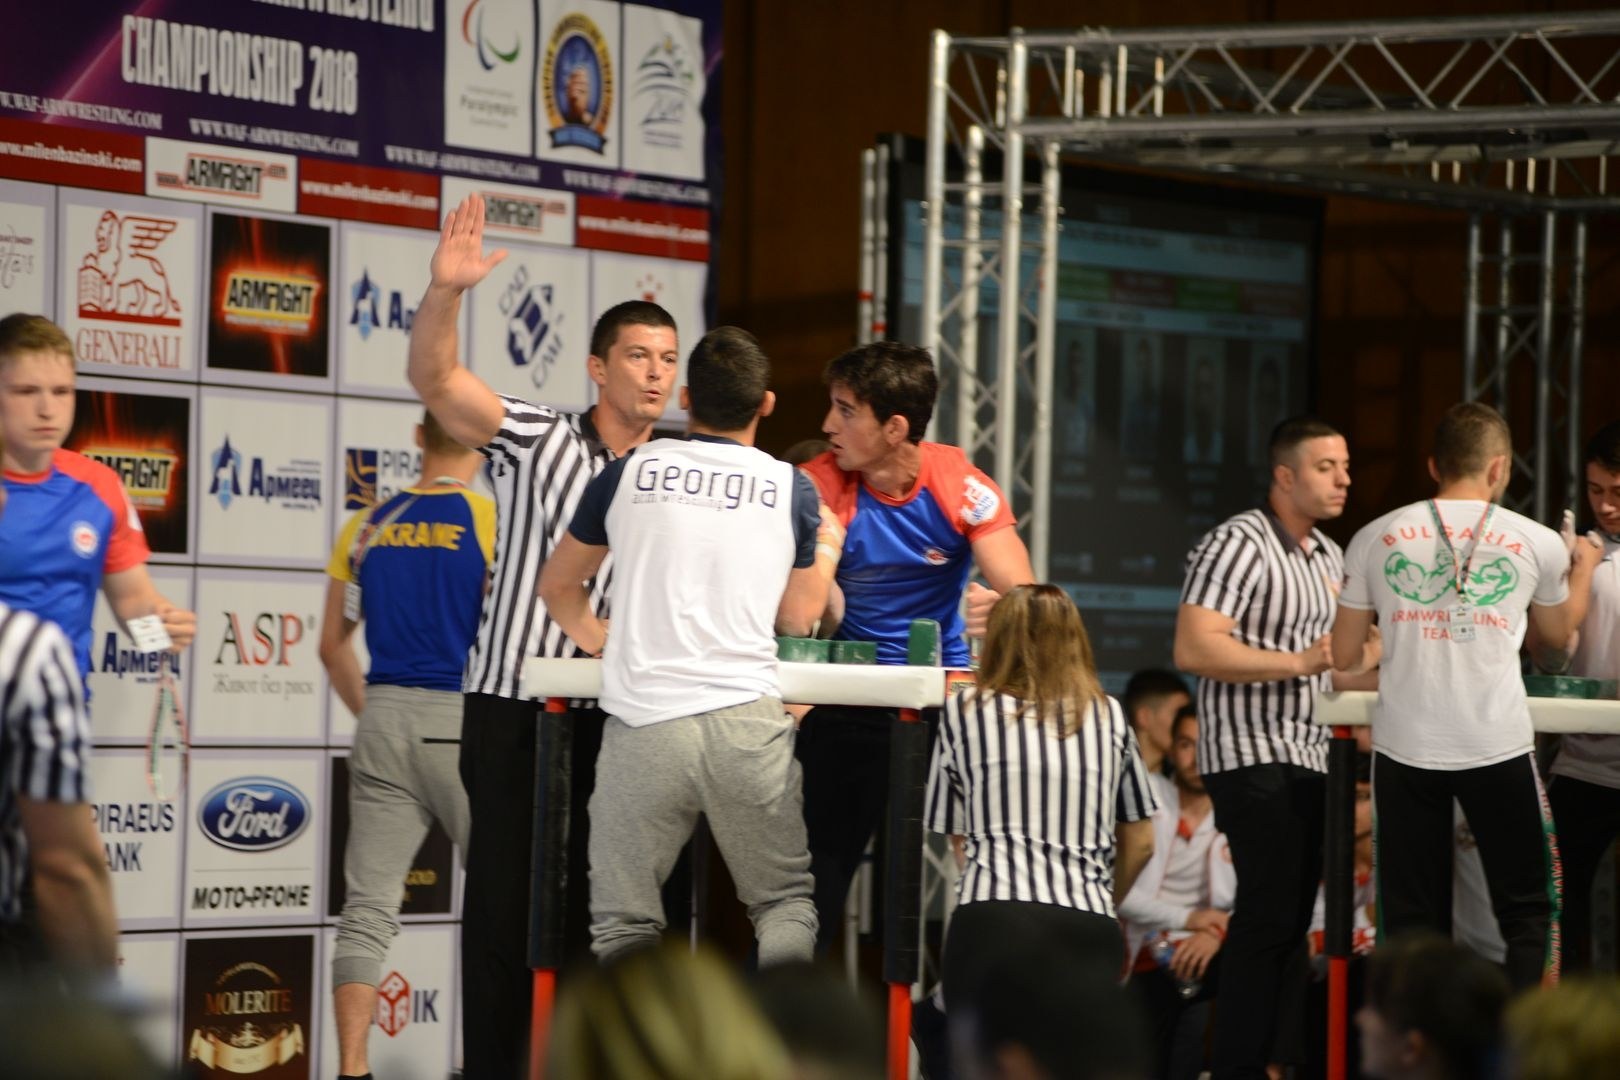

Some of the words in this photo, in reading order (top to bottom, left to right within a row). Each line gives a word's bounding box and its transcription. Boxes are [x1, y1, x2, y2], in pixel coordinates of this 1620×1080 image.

[121, 14, 304, 107] CHAMPIONSHIP
[309, 45, 359, 116] 2018
[0, 91, 163, 130] W.WAF-ARMWRESTLING.COM
[228, 278, 314, 315] ARMFIGHT
[76, 328, 181, 368] GENERALI
[249, 457, 322, 507] Армеец
[382, 450, 424, 479] PIRA
[636, 458, 778, 510] Georgia
[1383, 525, 1524, 556] BULGARIA
[1391, 609, 1509, 630] ARMWRLING
[1423, 626, 1454, 640] TEA
[215, 611, 304, 666] ASP
[217, 788, 290, 838] Ford
[105, 842, 142, 873] ANK
[191, 884, 311, 910] MOTO-PFOHE
[204, 990, 293, 1016] MOLERITE
